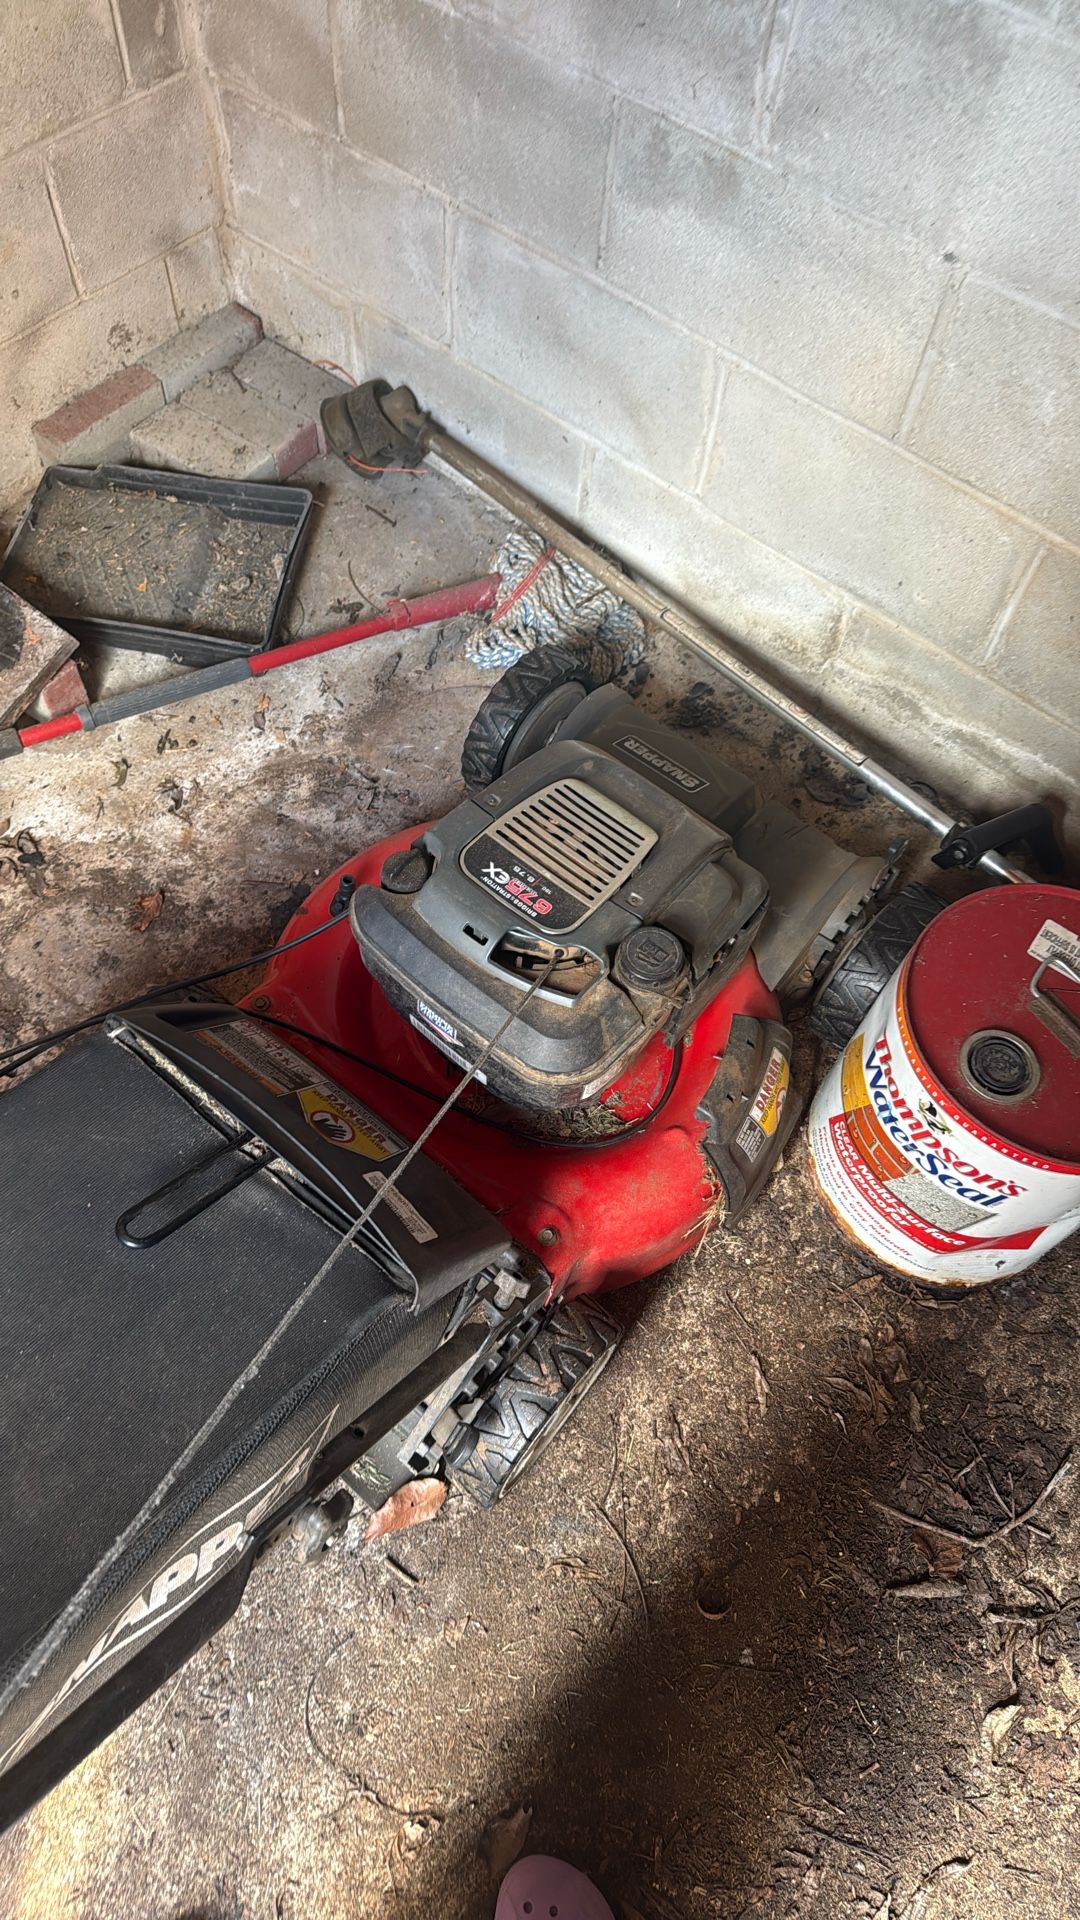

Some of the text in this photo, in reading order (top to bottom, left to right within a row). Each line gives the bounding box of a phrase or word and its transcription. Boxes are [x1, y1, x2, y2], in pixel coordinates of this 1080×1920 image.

[623, 737, 700, 788] SNAPPER
[482, 876, 512, 900] STRATTON
[513, 899, 538, 918] BRIGGS
[755, 1058, 781, 1112] DANGER
[326, 1093, 386, 1144] DANGER
[875, 1034, 1028, 1198] Thompson's
[953, 1114, 1050, 1169] GUARANTEED
[834, 1122, 912, 1227] Waterproofer
[836, 1170, 855, 1198] Water
[856, 1201, 891, 1234] Damage
[840, 1121, 967, 1246] CLEAR Multi-Surface
[825, 1161, 842, 1189] Wood
[849, 1202, 868, 1222] Gray
[869, 1223, 912, 1256] Naturally
